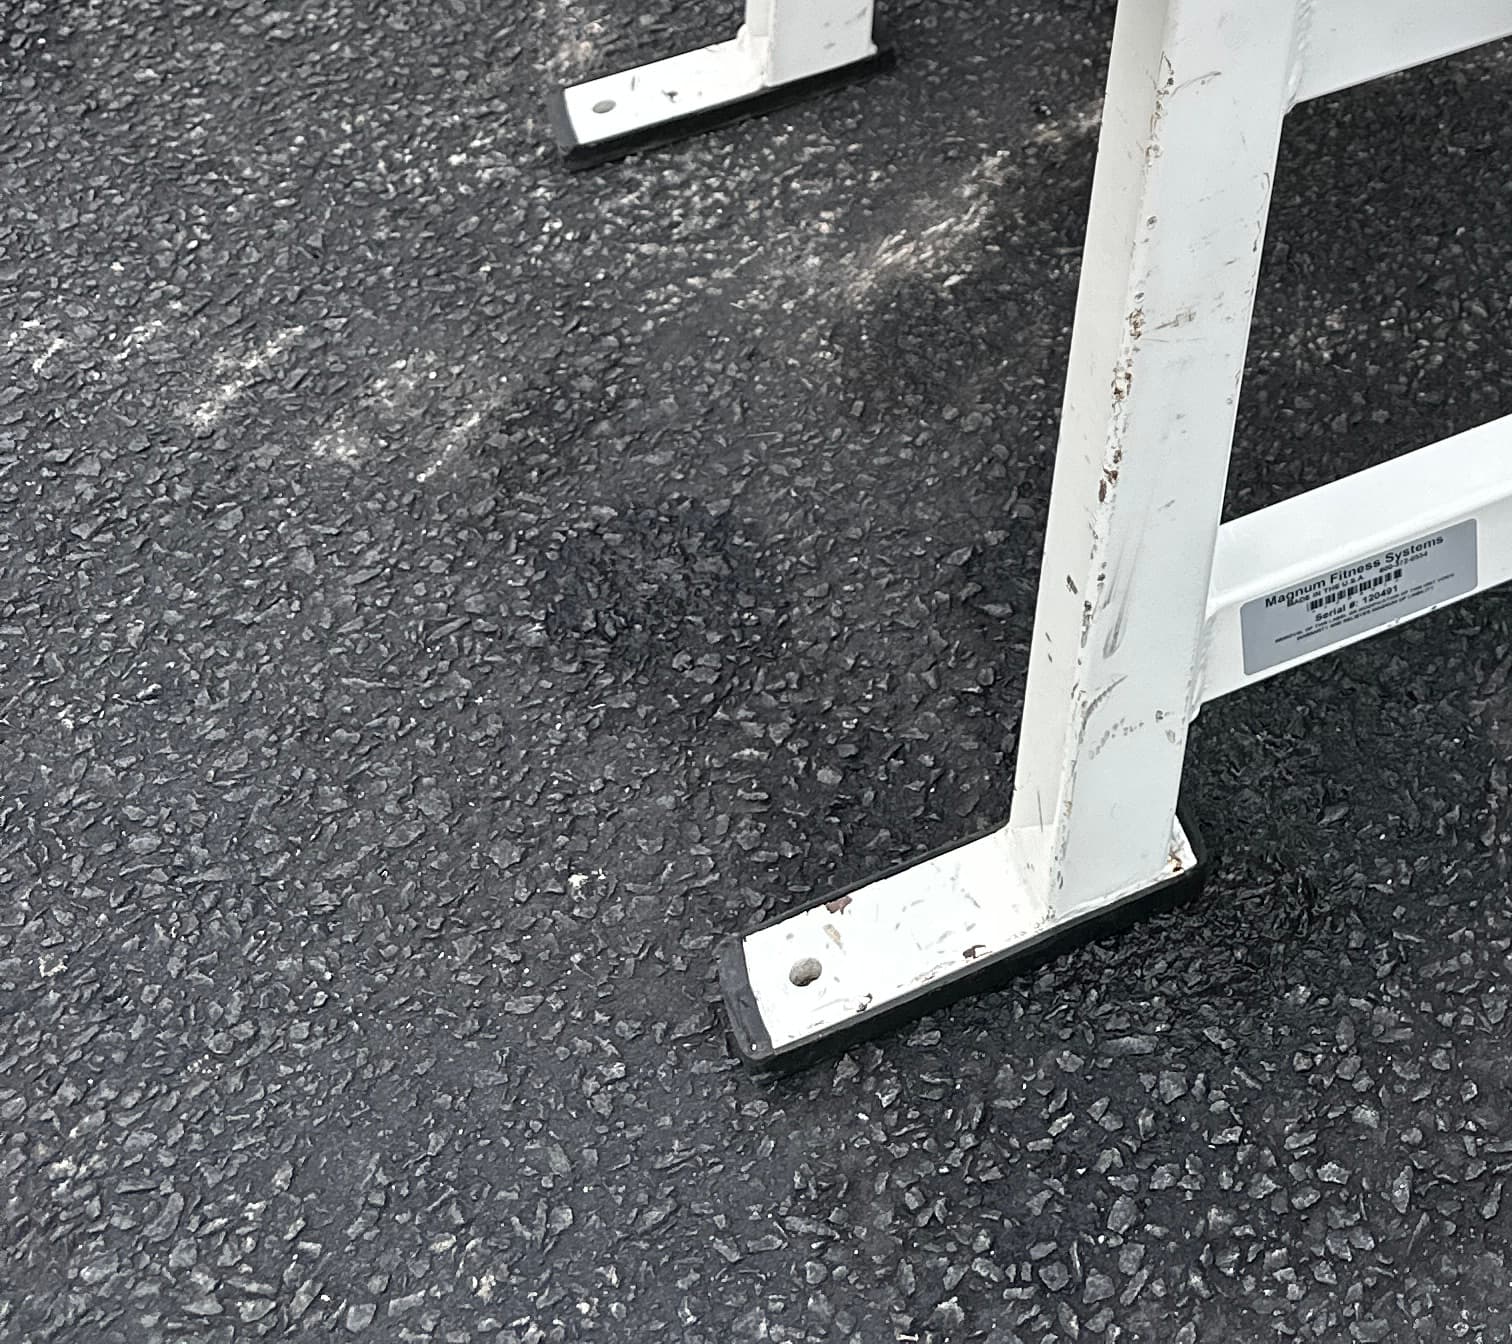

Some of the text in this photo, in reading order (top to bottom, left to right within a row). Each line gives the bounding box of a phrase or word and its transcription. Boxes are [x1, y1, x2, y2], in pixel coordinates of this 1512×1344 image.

[1264, 579, 1326, 608] Magnum
[1330, 559, 1381, 585] Fitness
[1384, 536, 1444, 564] Systems
[1315, 604, 1346, 622] Serial
[1362, 584, 1398, 604] 120491
